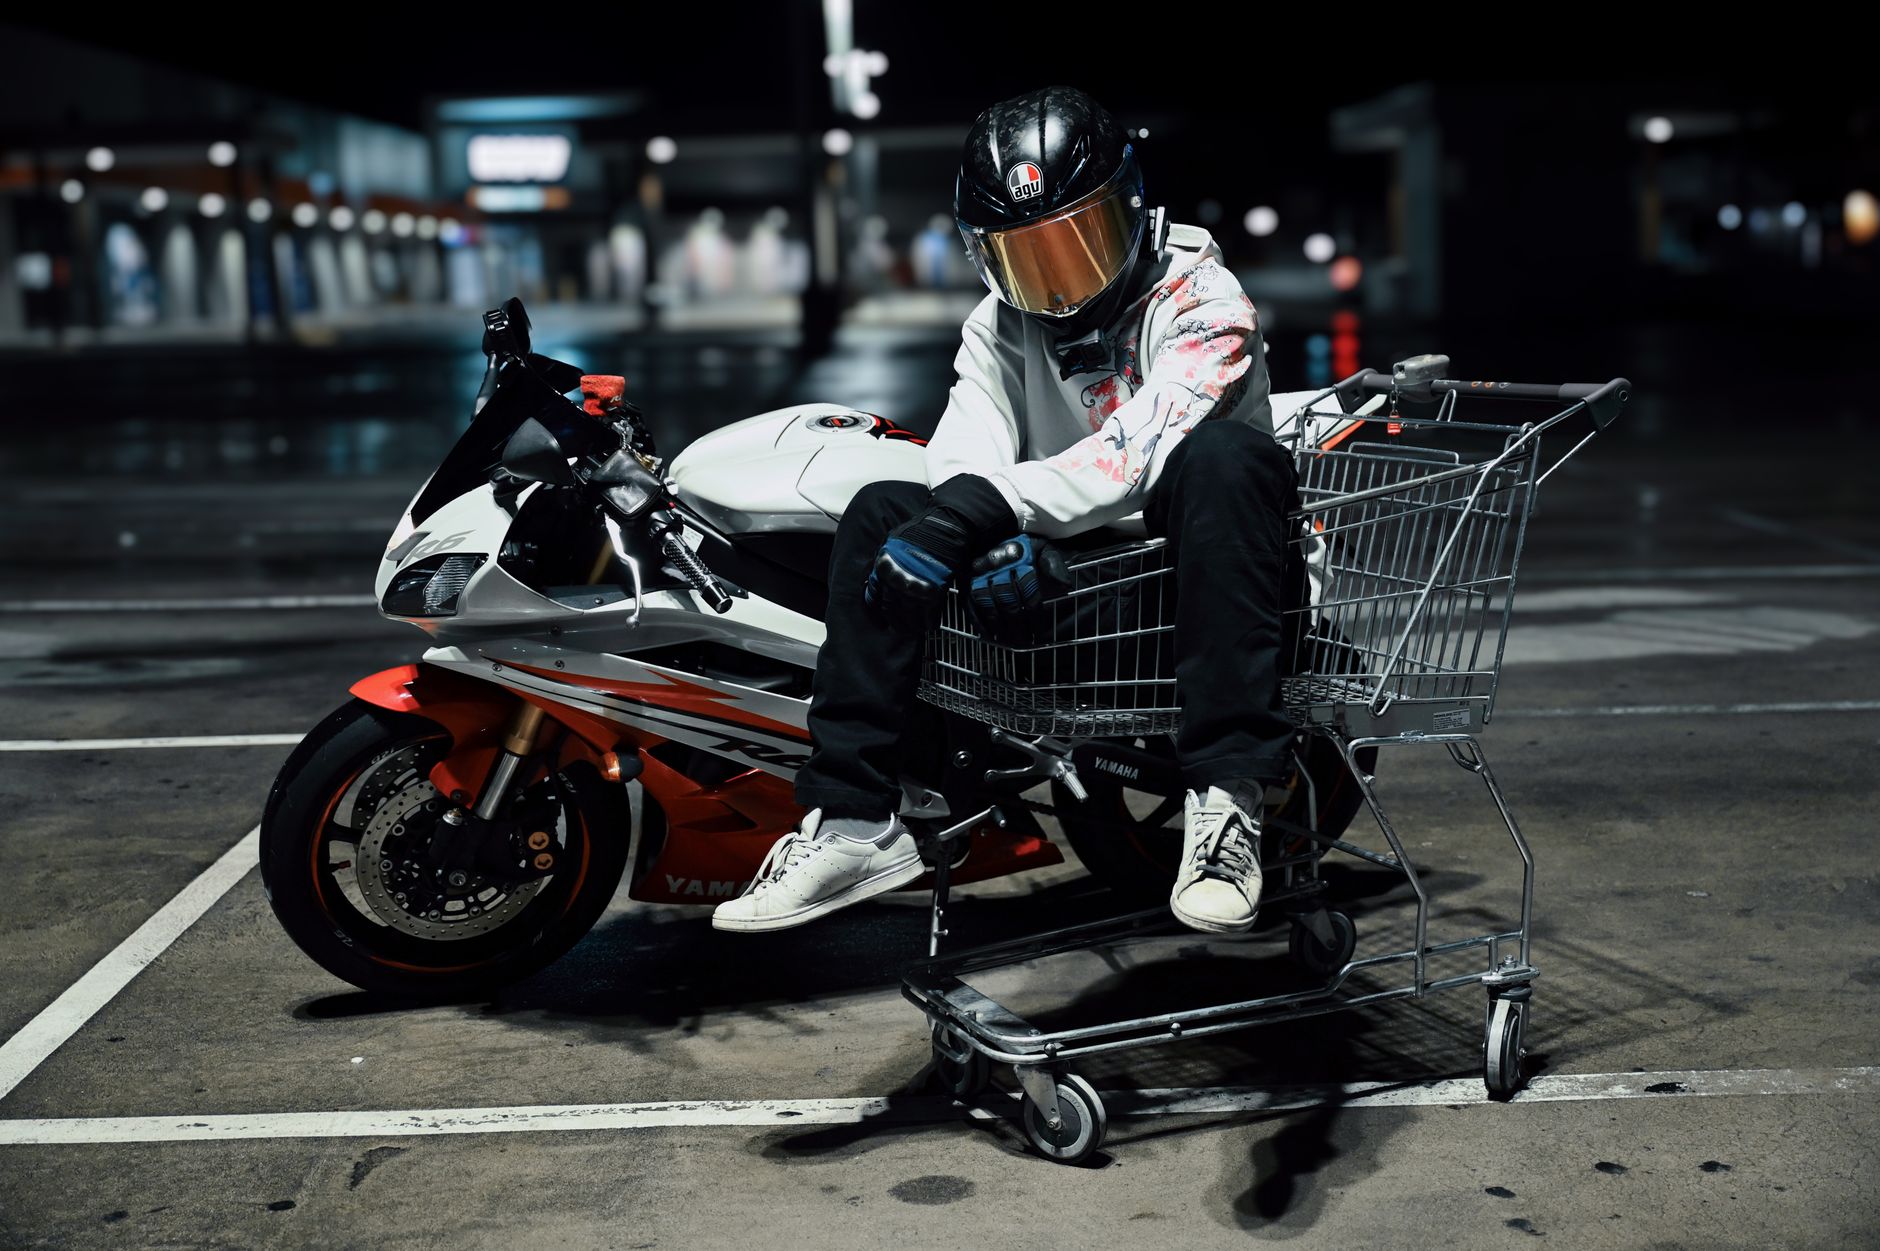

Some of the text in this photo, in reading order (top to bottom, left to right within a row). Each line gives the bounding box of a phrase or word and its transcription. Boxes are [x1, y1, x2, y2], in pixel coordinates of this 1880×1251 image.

[1014, 181, 1040, 199] agv
[398, 529, 477, 569] R6
[1094, 756, 1139, 780] YAMAHA
